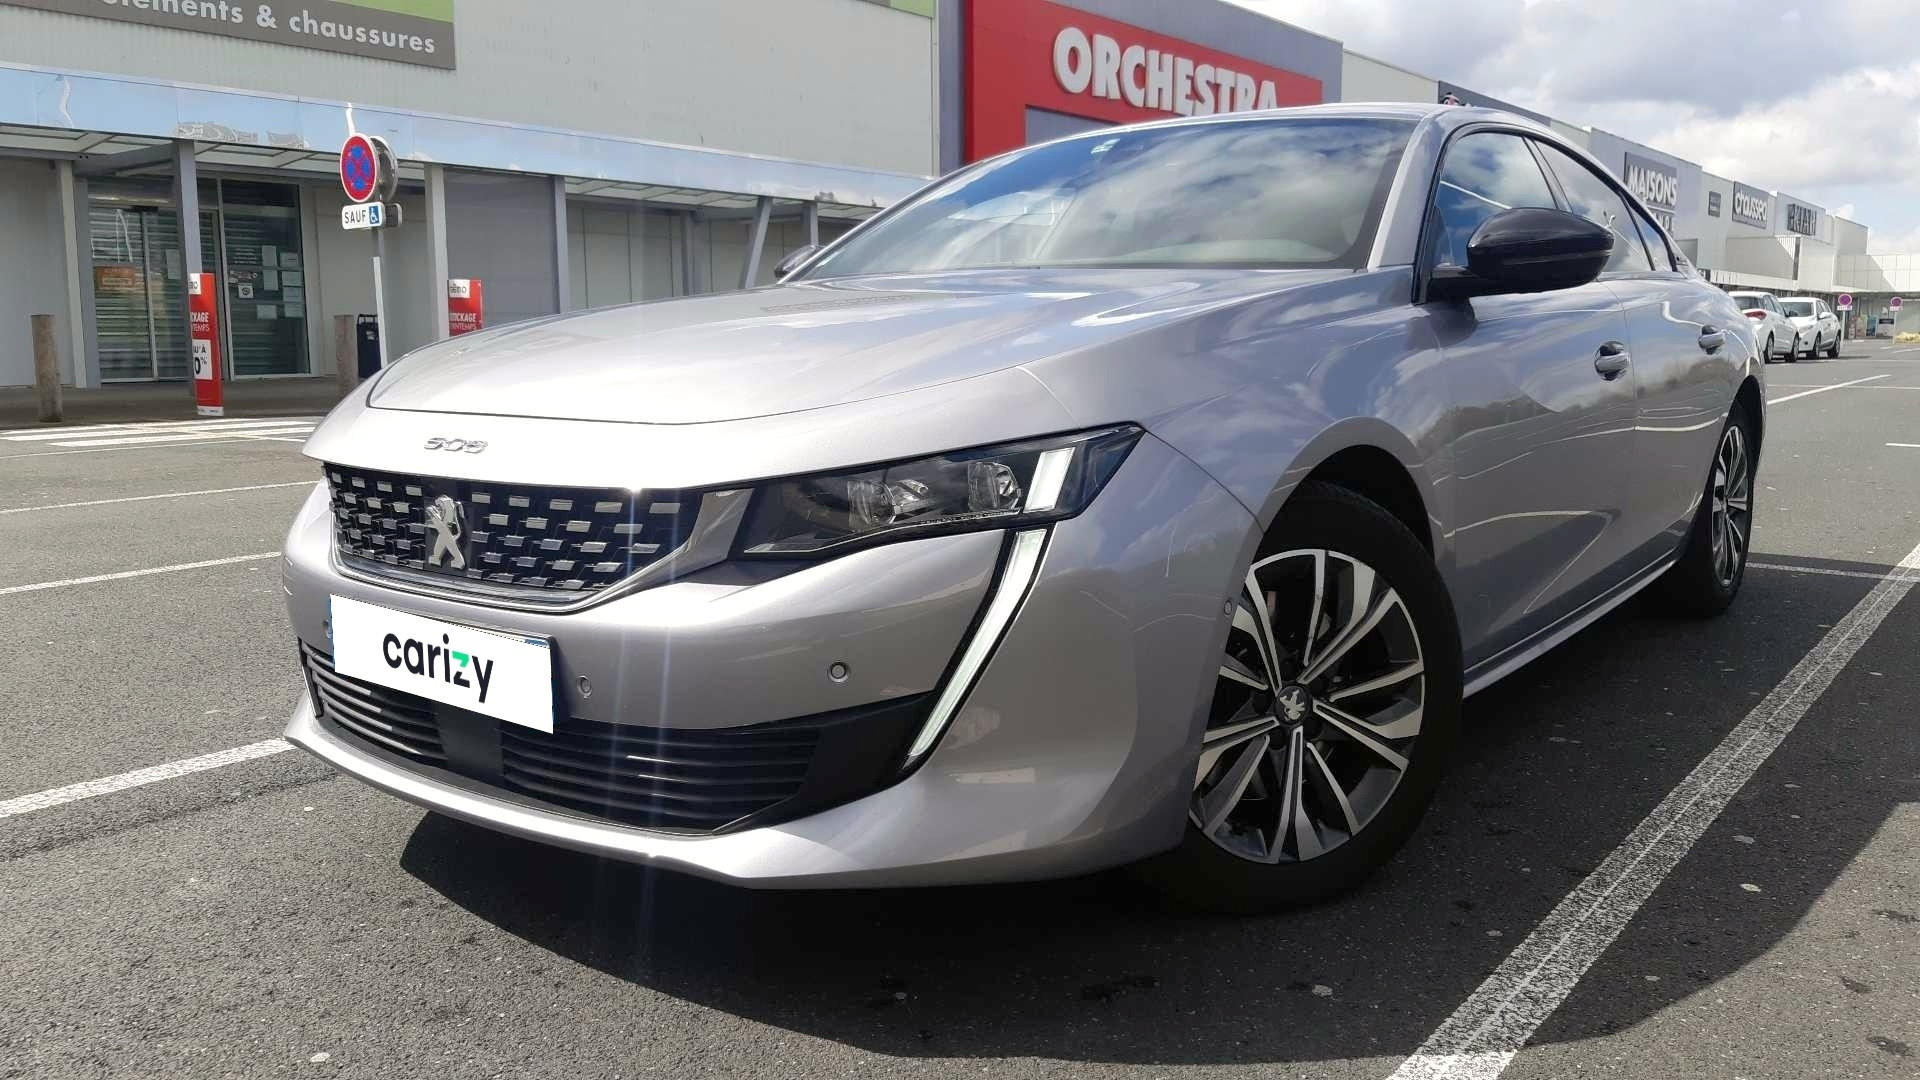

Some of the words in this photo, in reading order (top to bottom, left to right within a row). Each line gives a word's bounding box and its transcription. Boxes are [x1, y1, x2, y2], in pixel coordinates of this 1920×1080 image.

[256, 4, 278, 29] &
[289, 10, 436, 53] chaussures
[1053, 27, 1279, 117] ORCHESTRA
[1627, 164, 1678, 206] MAISONS
[344, 209, 366, 224] SAUF
